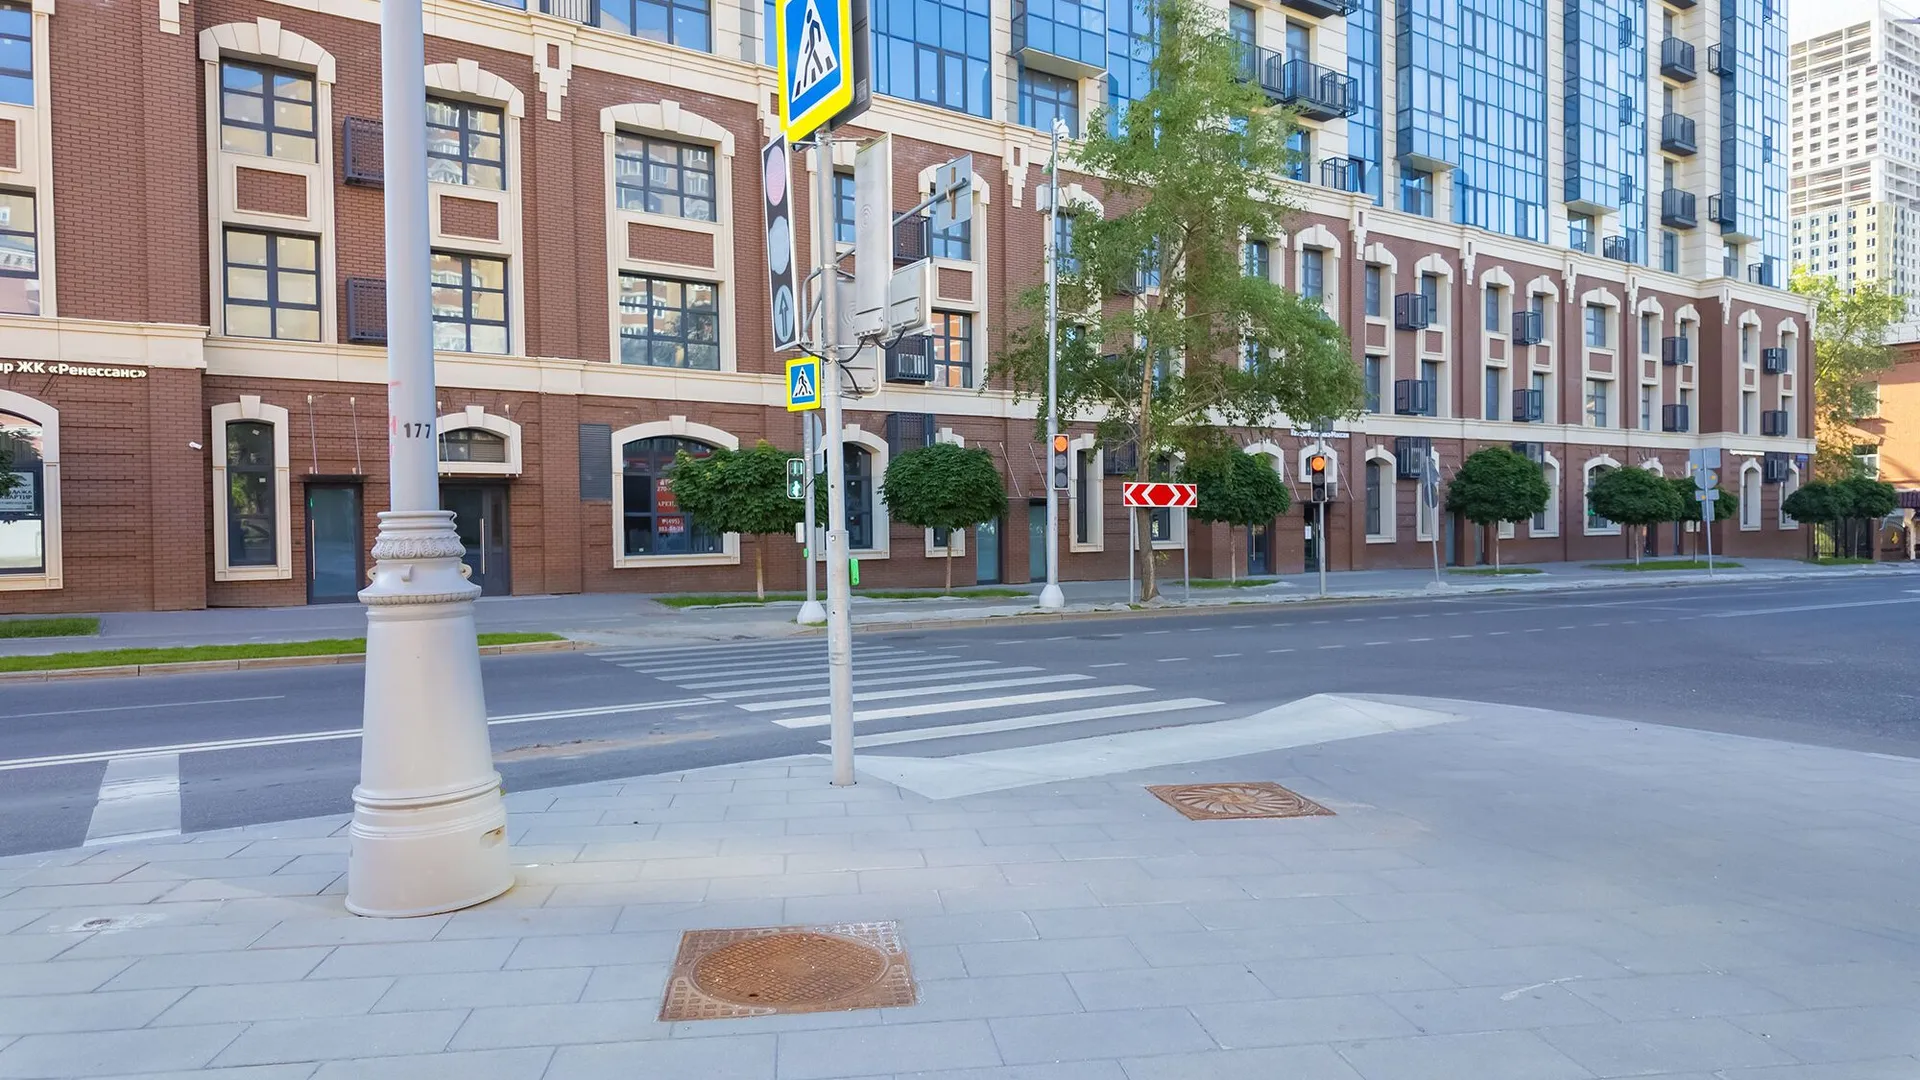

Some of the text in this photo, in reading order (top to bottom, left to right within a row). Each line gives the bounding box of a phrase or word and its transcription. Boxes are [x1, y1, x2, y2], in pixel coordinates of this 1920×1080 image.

[16, 360, 46, 374] ЖК
[48, 363, 147, 378] «Ренессанс»
[403, 422, 431, 439] 177
